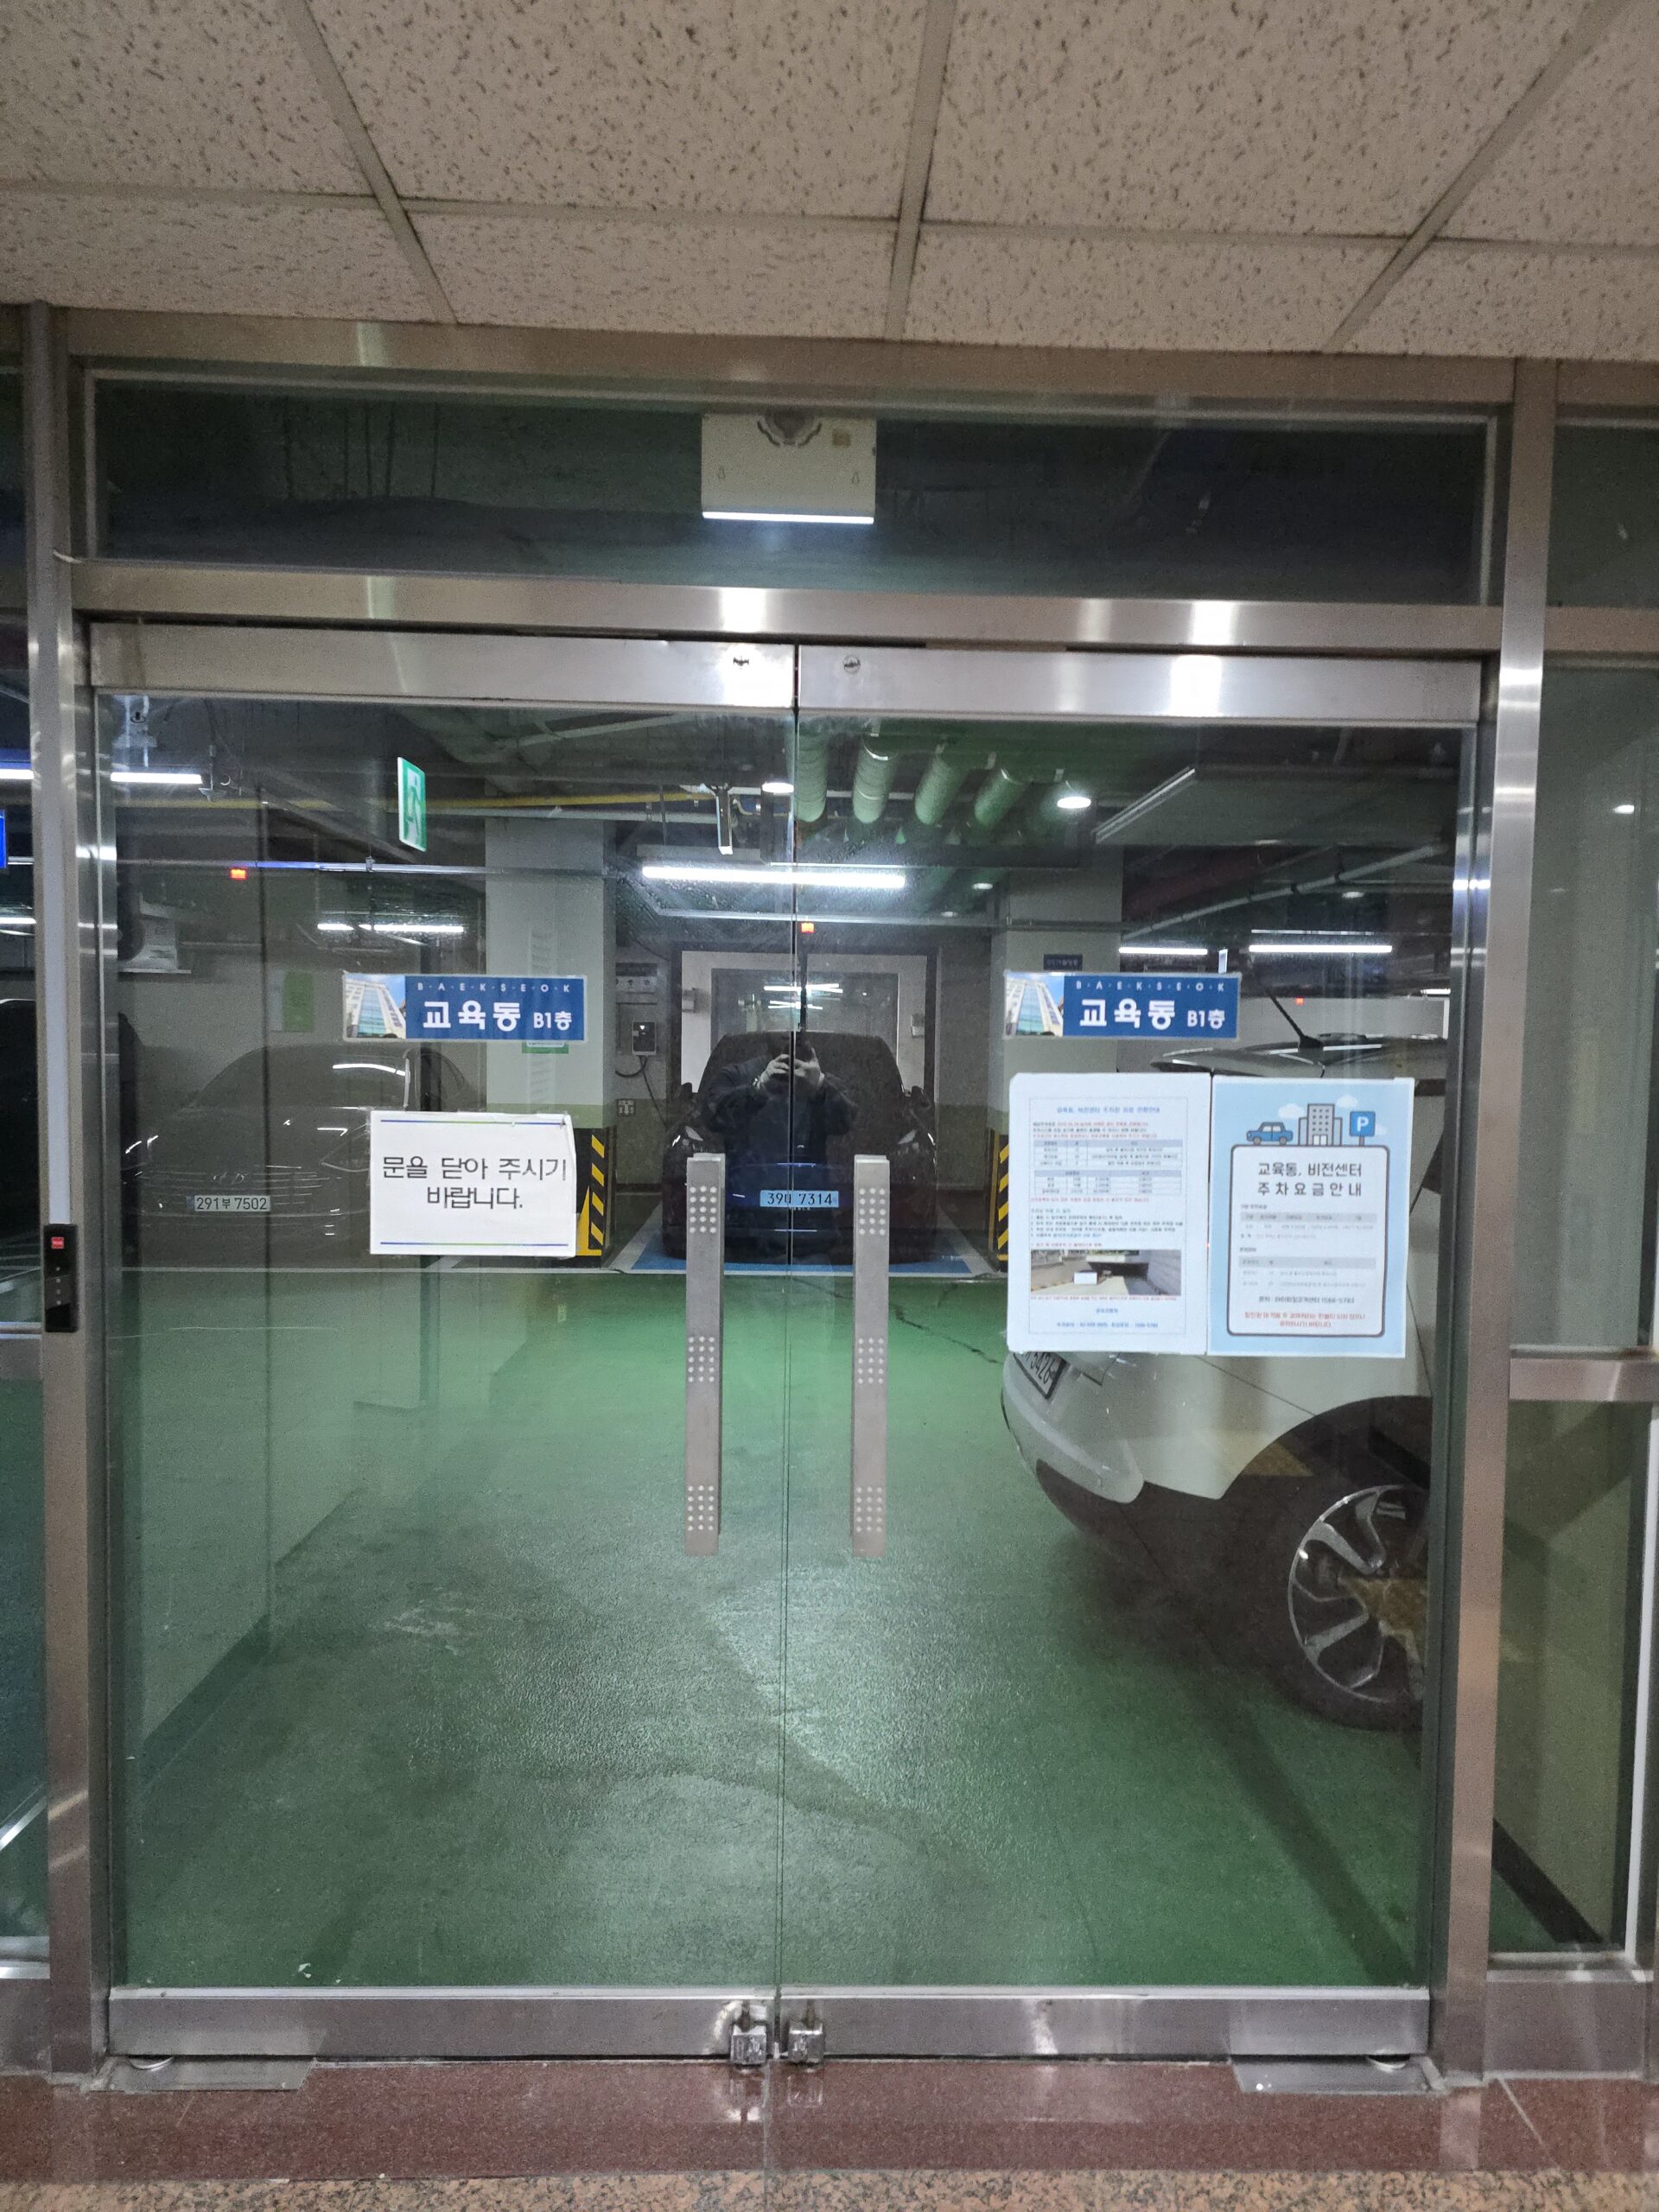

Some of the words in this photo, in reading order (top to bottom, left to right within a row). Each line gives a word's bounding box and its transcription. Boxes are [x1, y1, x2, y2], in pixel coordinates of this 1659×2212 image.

[423, 1000, 521, 1032] 교육동
[533, 1011, 573, 1031] B1층
[1079, 998, 1175, 1030] 교육동
[1186, 1008, 1225, 1029] B1층
[383, 1155, 428, 1179] 문을
[441, 1157, 488, 1180] 닫아
[499, 1158, 567, 1181] 주시기
[1258, 1162, 1302, 1177] 교육동,
[1307, 1162, 1362, 1177] 비전센터
[196, 1197, 231, 1211] 291부
[234, 1197, 267, 1211] 7502
[427, 1186, 524, 1210] 바랍니다.
[798, 1192, 833, 1205] 7314
